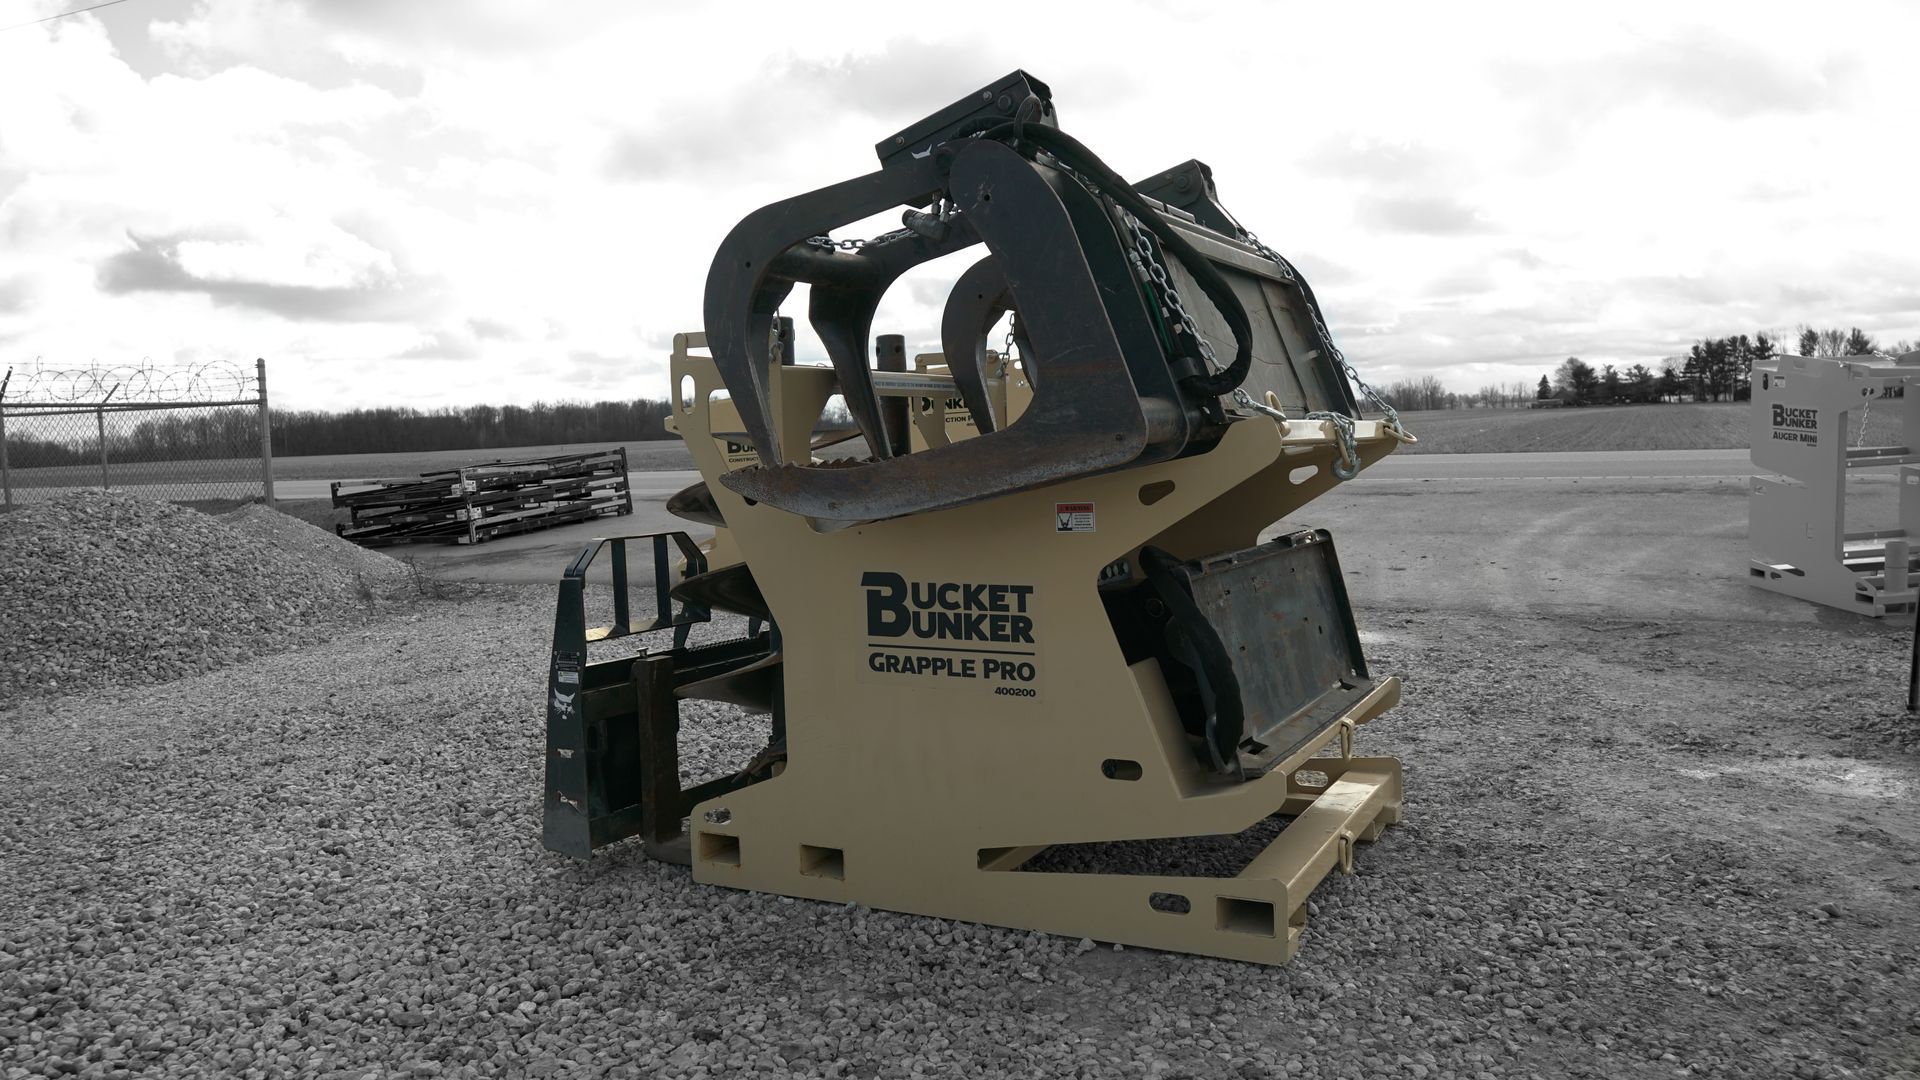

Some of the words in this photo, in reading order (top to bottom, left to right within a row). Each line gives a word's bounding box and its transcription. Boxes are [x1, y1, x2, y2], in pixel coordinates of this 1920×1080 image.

[1772, 404, 1818, 421] BUCKET
[1773, 412, 1818, 429] BUNKER
[1773, 431, 1798, 442] AUGER
[1800, 434, 1818, 443] MINI
[861, 572, 1034, 617] BUCKET
[866, 594, 1035, 644] BUNKER
[868, 652, 977, 678] GRAPPLE
[982, 658, 1036, 682] PRO
[994, 686, 1036, 698] 400200
